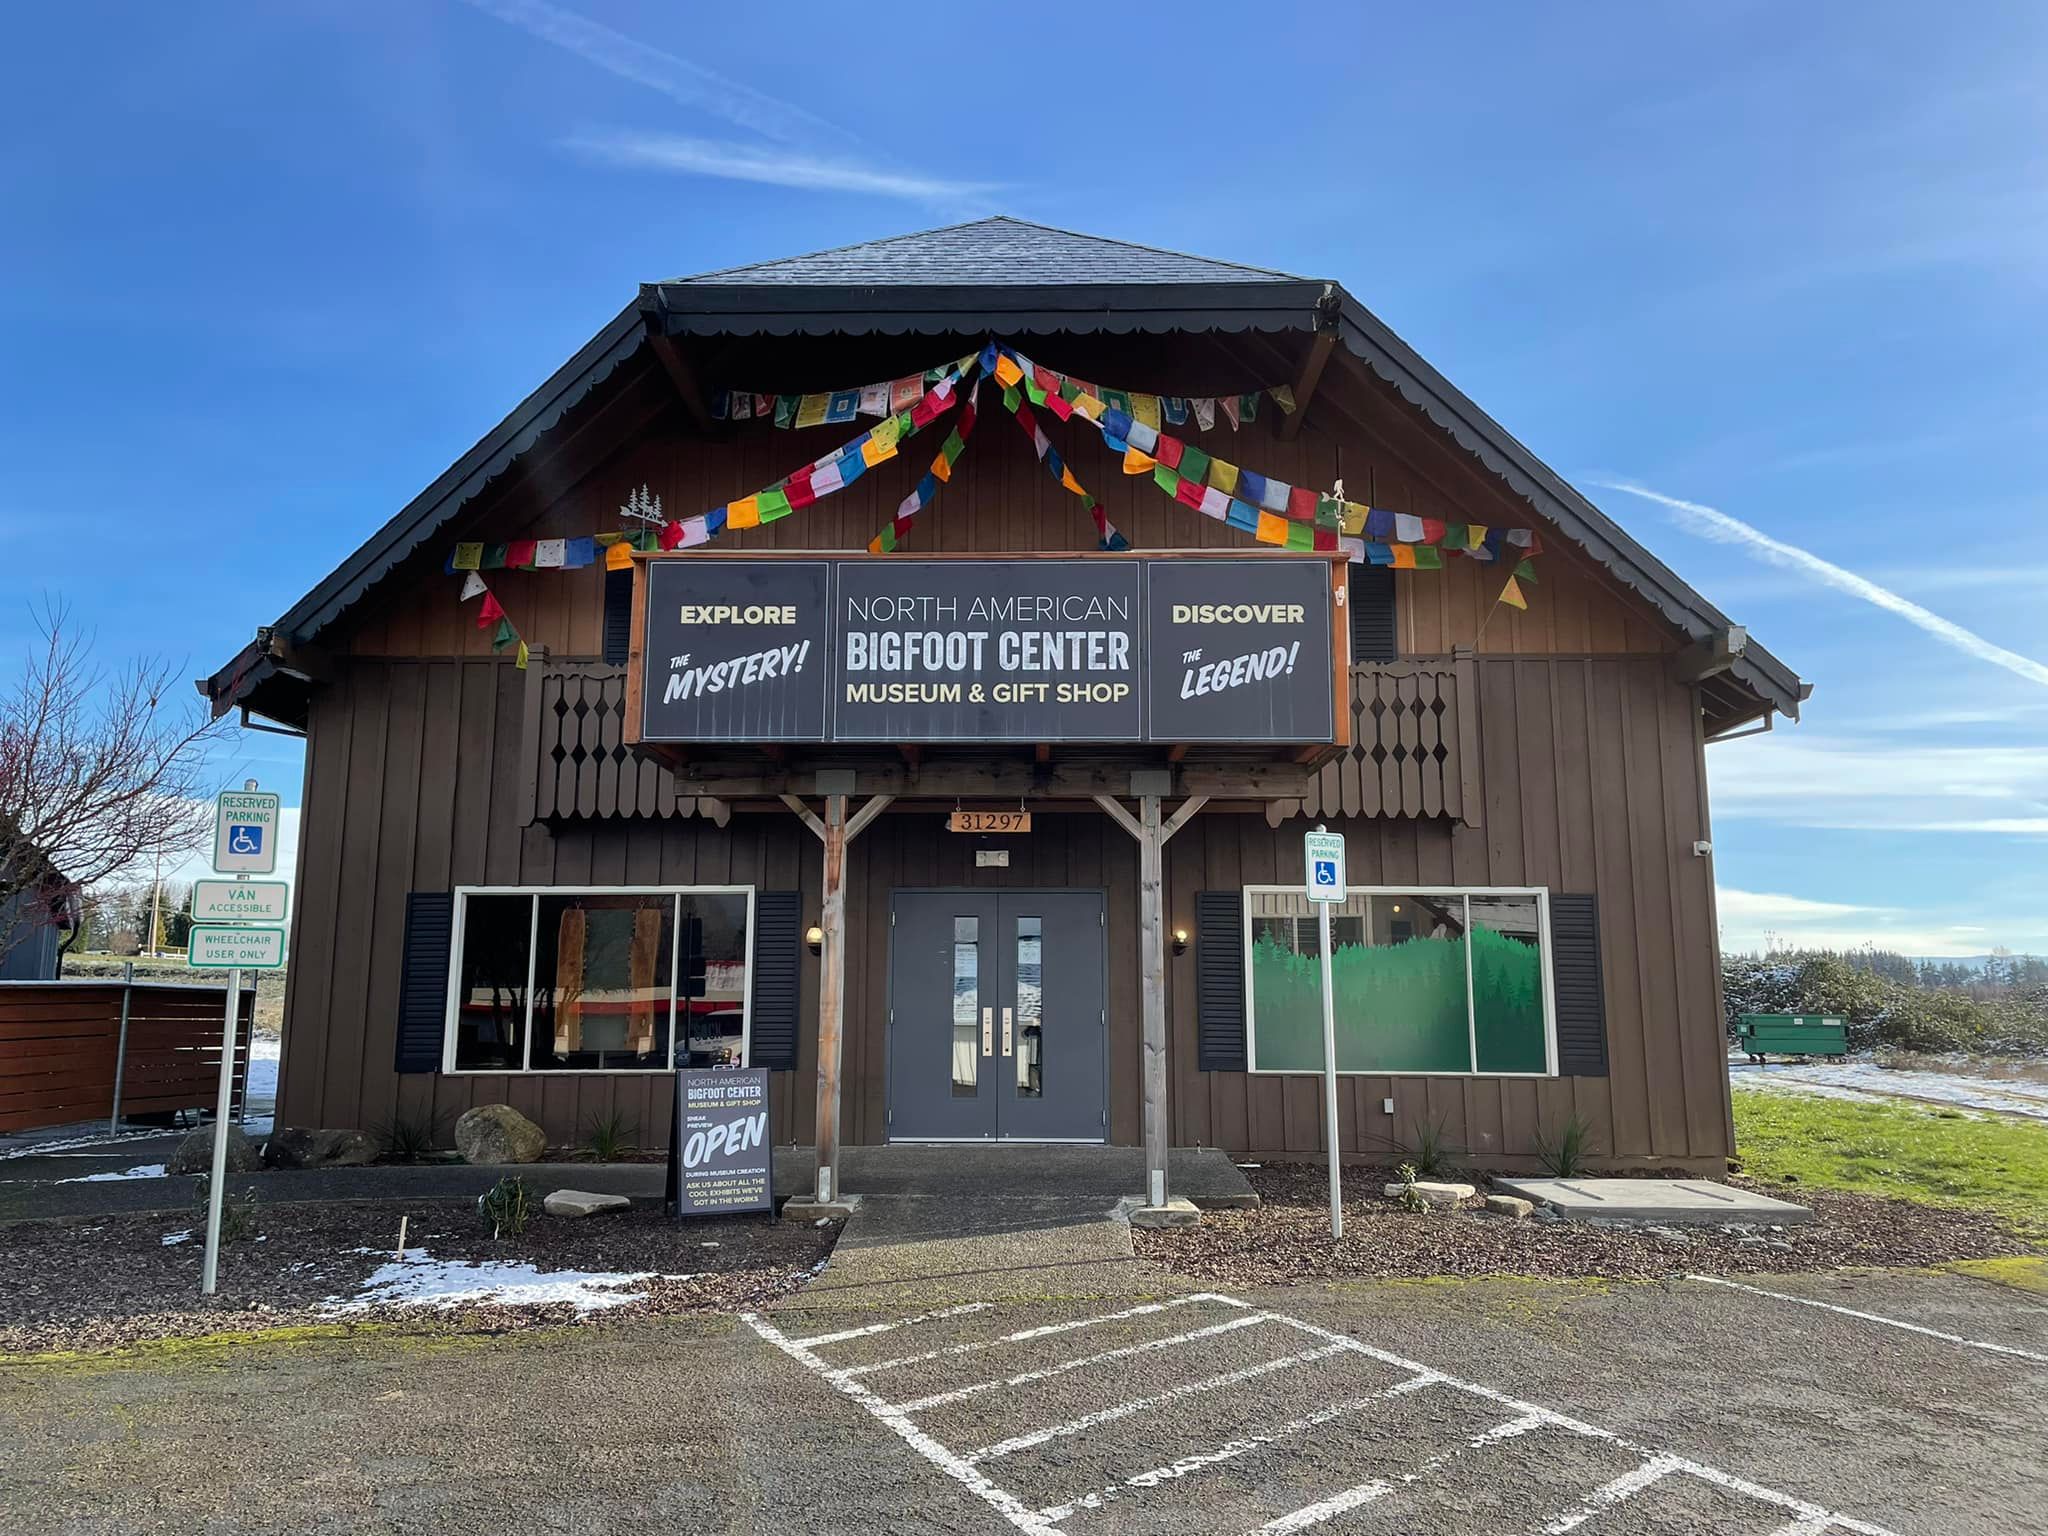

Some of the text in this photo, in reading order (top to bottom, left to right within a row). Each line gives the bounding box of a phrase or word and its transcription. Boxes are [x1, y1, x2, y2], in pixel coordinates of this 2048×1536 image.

[680, 605, 797, 625] EXPLORE
[848, 596, 1128, 622] NORTH AMERICAN
[1172, 605, 1305, 624] DISCOVER
[846, 631, 1130, 671] BIGFOOT CENTER
[1182, 648, 1203, 664] THE
[670, 653, 691, 669] THE
[663, 639, 810, 704] MYSTERY!
[1179, 641, 1301, 700] LEGEND!
[846, 684, 1129, 703] MUSEUM & GIFT SHOP
[222, 797, 276, 810] RESERVED
[225, 811, 270, 823] PARKING
[961, 814, 1024, 830] 31297
[1308, 837, 1341, 848] RESERVED
[1311, 849, 1339, 860] PARKING
[228, 890, 256, 900] VAN
[208, 904, 272, 913] ACCESSIBLE
[205, 935, 272, 945] WHEELCHAIR
[206, 950, 266, 959] USER ONLY
[687, 1077, 761, 1087] NORTH AMERICAN
[687, 1086, 761, 1100] BIGFOOT CENTER
[687, 1101, 719, 1109] MUSEUM
[726, 1100, 741, 1108] GIFT
[742, 1099, 761, 1107] SHOP
[683, 1112, 767, 1168] OPEN
[736, 1167, 766, 1175] CREATION
[712, 1180, 737, 1188] ABOUT
[688, 1190, 708, 1198] COOL
[709, 1189, 742, 1197] EXHIBITS
[709, 1198, 718, 1206] IN
[734, 1195, 759, 1204] WORKS
